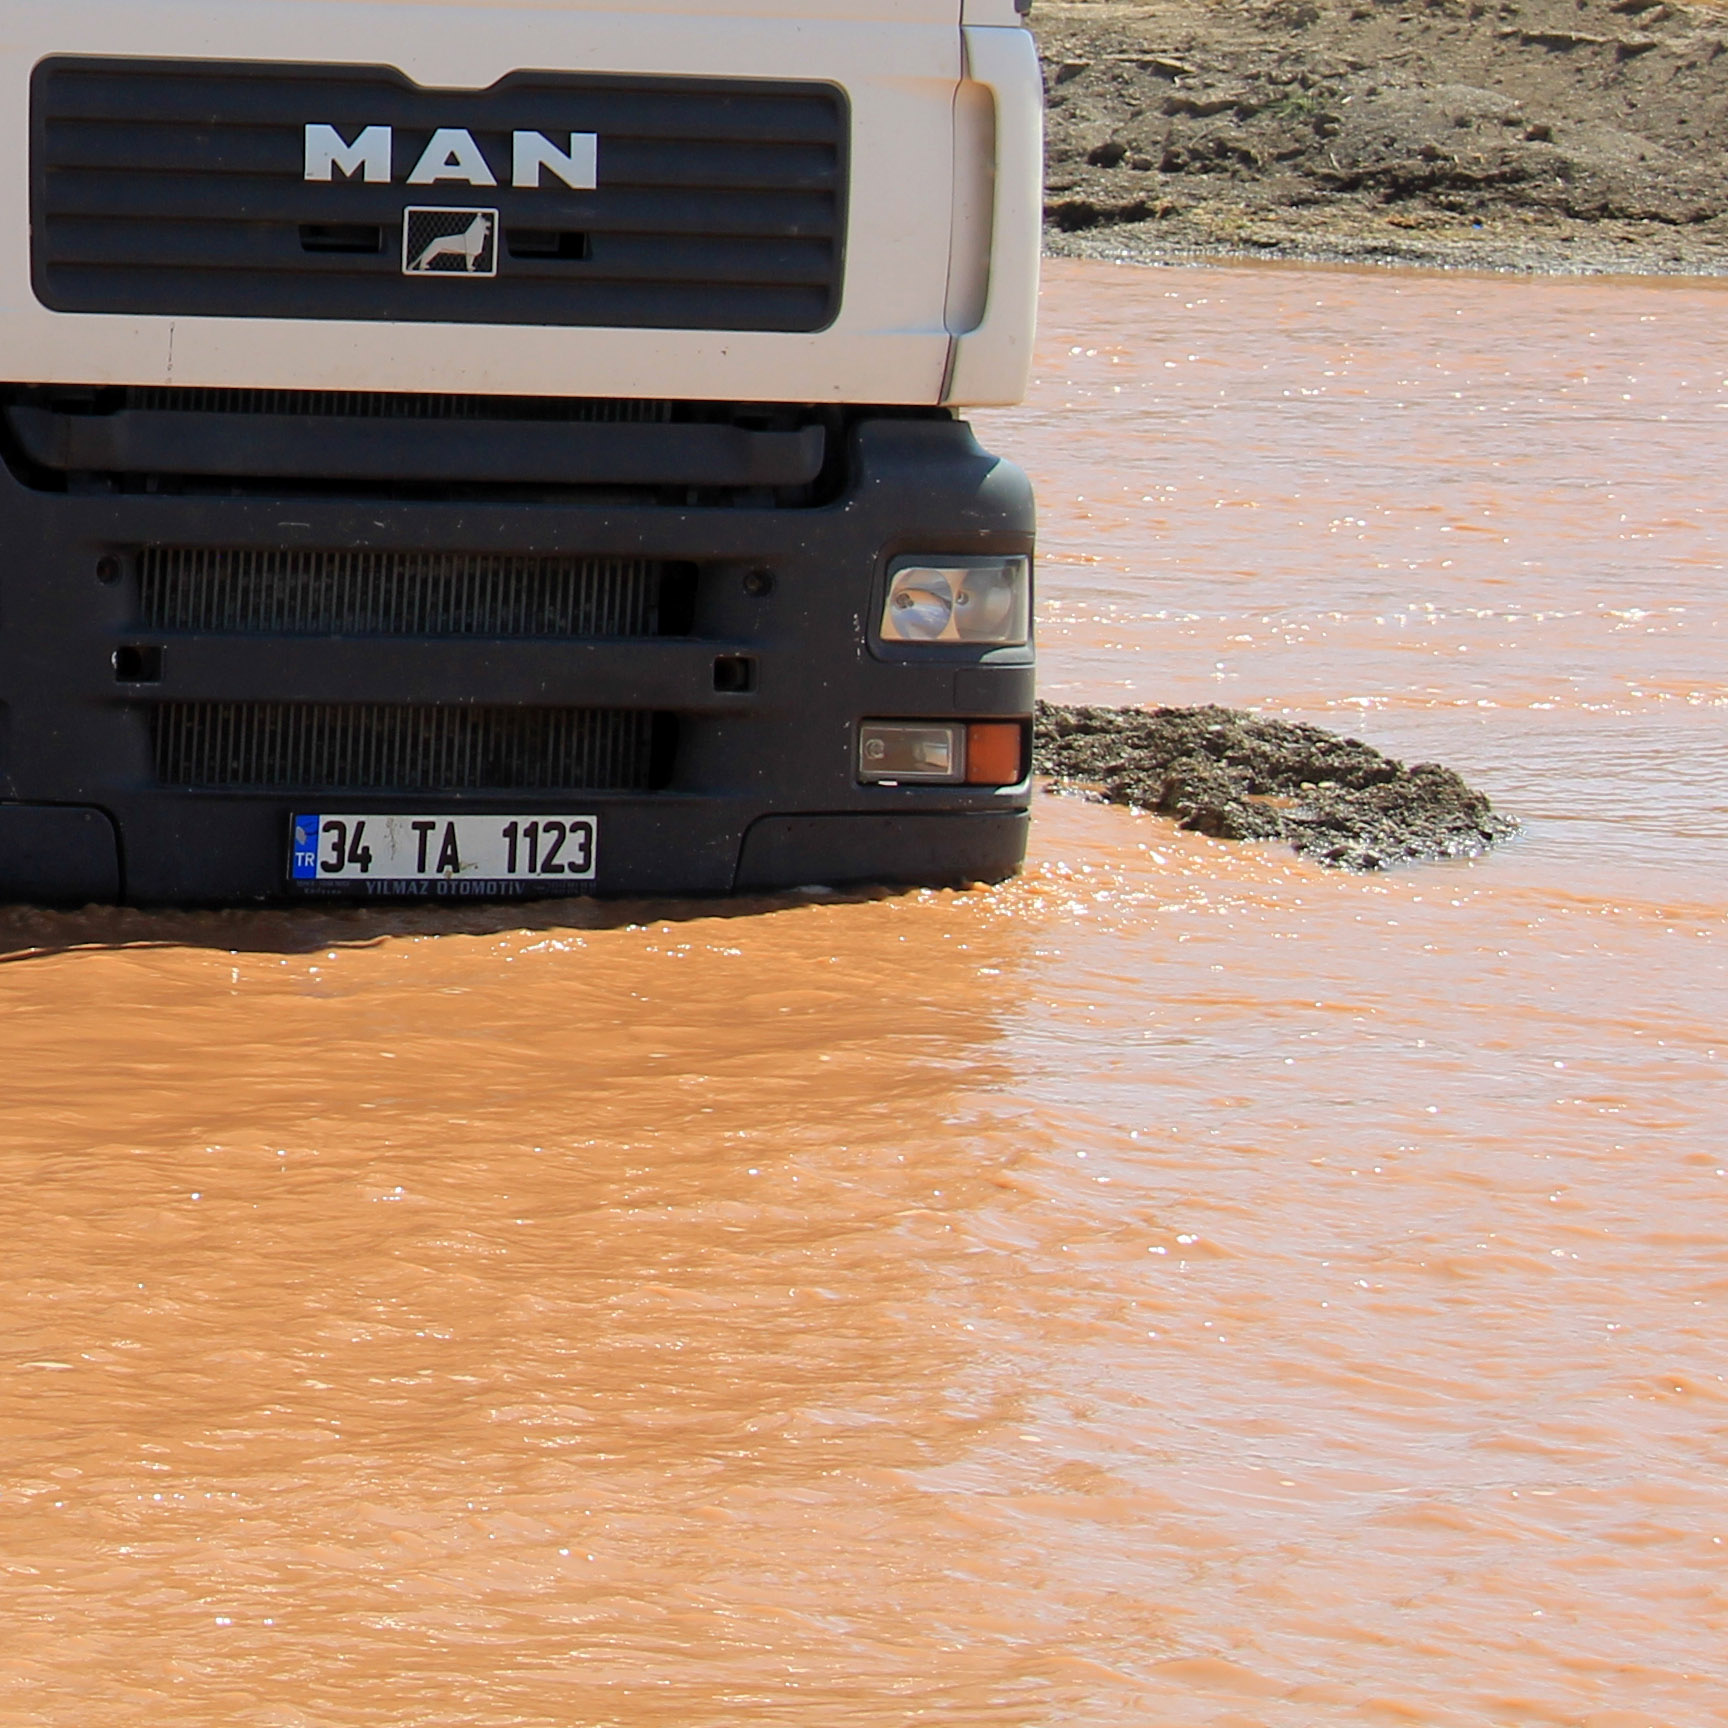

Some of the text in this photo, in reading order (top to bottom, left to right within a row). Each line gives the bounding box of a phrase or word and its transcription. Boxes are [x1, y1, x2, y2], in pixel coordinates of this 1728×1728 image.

[304, 123, 597, 189] MAN
[295, 821, 593, 873] TR 34 TA 1123
[365, 880, 428, 895] YILMAZ
